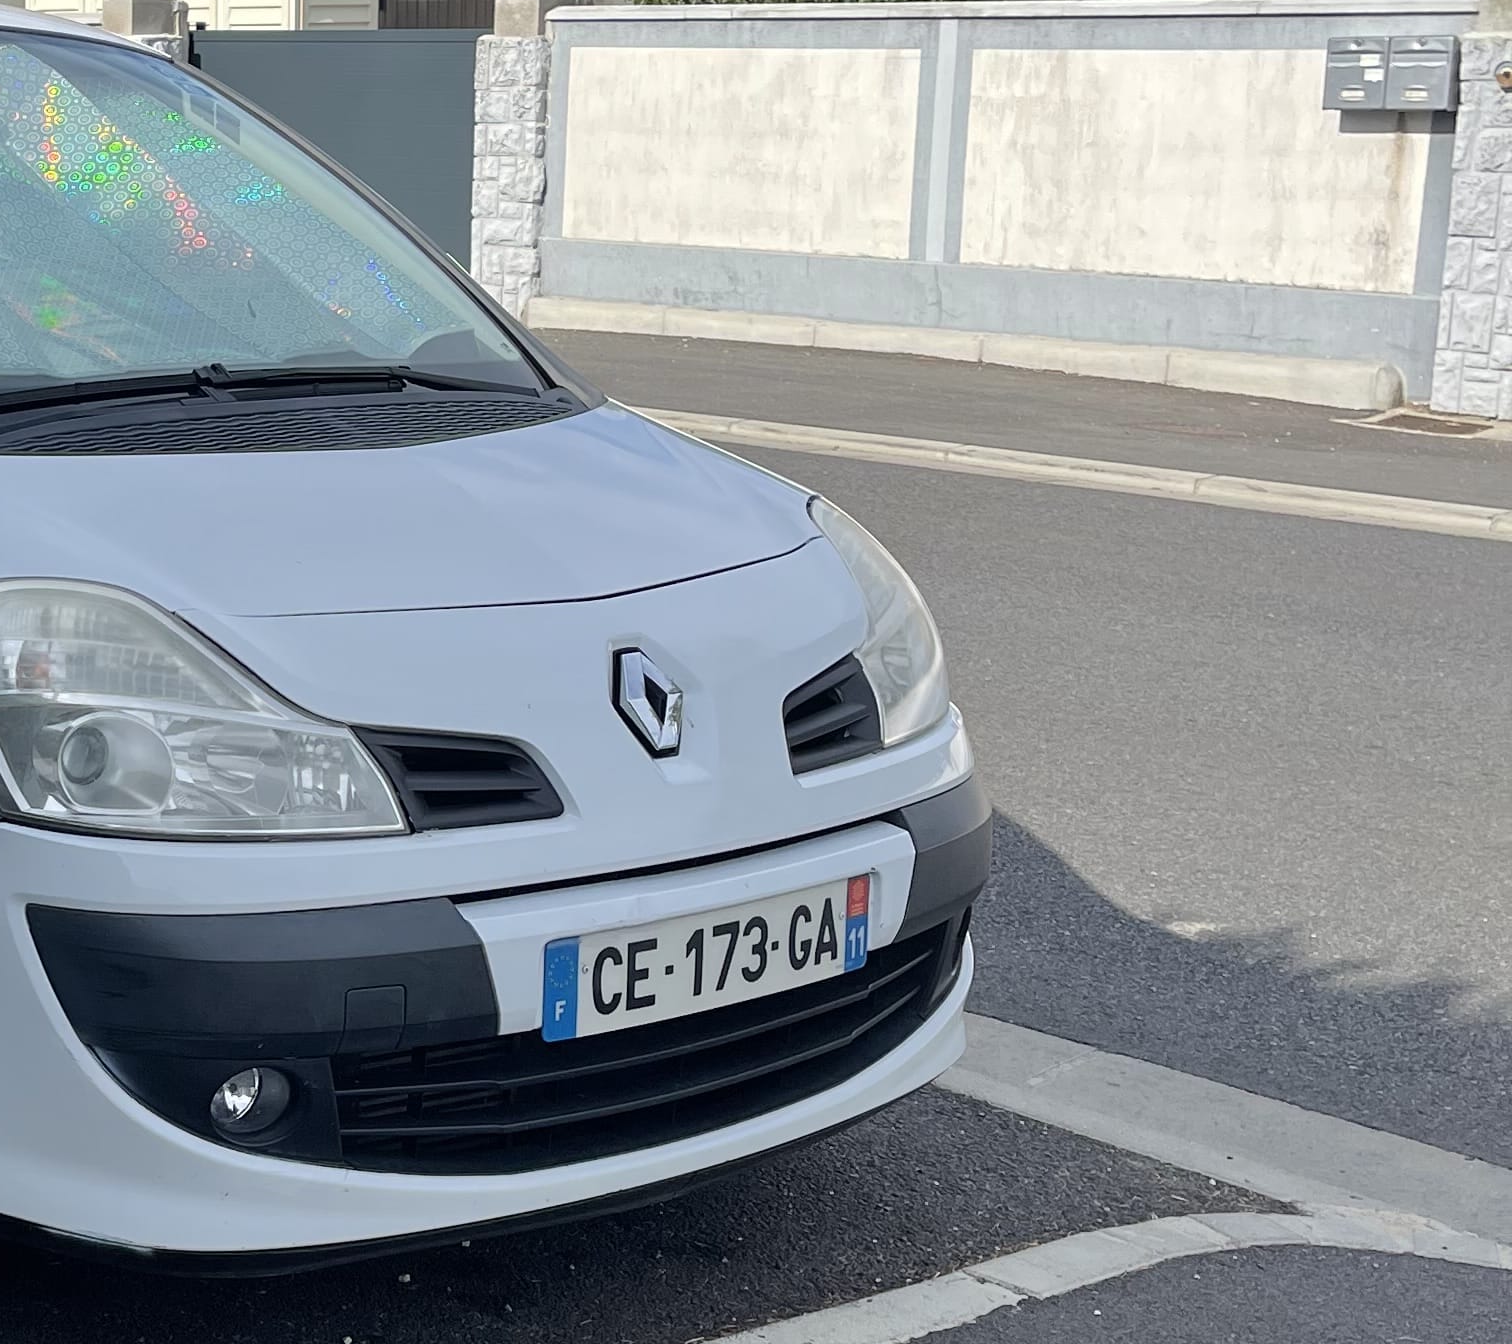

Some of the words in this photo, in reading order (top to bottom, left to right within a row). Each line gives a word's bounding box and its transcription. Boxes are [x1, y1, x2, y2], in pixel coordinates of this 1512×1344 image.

[592, 897, 838, 1015] CE-173-GA
[848, 925, 865, 959] 11
[555, 1000, 567, 1022] F
